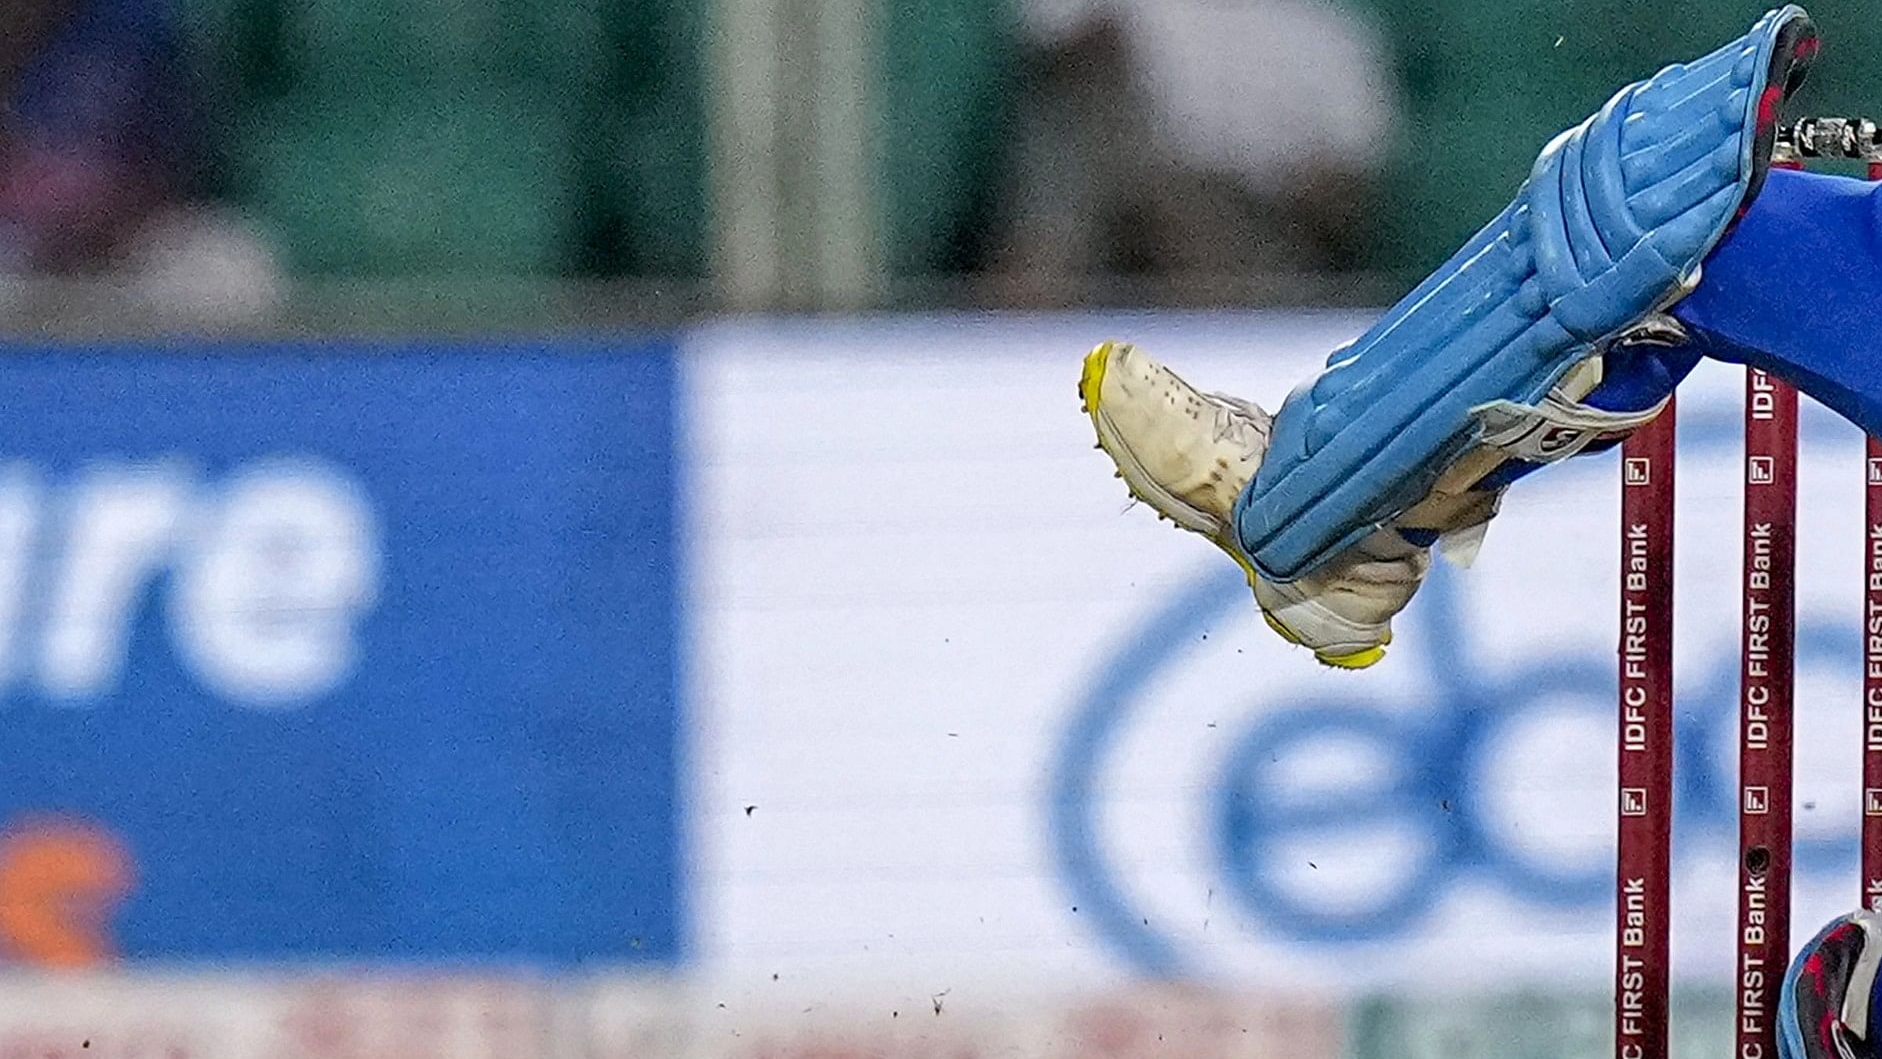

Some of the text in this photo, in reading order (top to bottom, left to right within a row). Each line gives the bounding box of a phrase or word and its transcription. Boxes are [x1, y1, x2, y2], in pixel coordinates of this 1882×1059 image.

[1625, 524, 1648, 751] IDFC FIRST Bank
[1747, 522, 1771, 749] IDFC FIRST Bank
[1623, 878, 1644, 946] Bank
[1743, 877, 1766, 944] Bank
[1622, 955, 1644, 1035] FIRST
[1743, 953, 1764, 1033] FIRST
